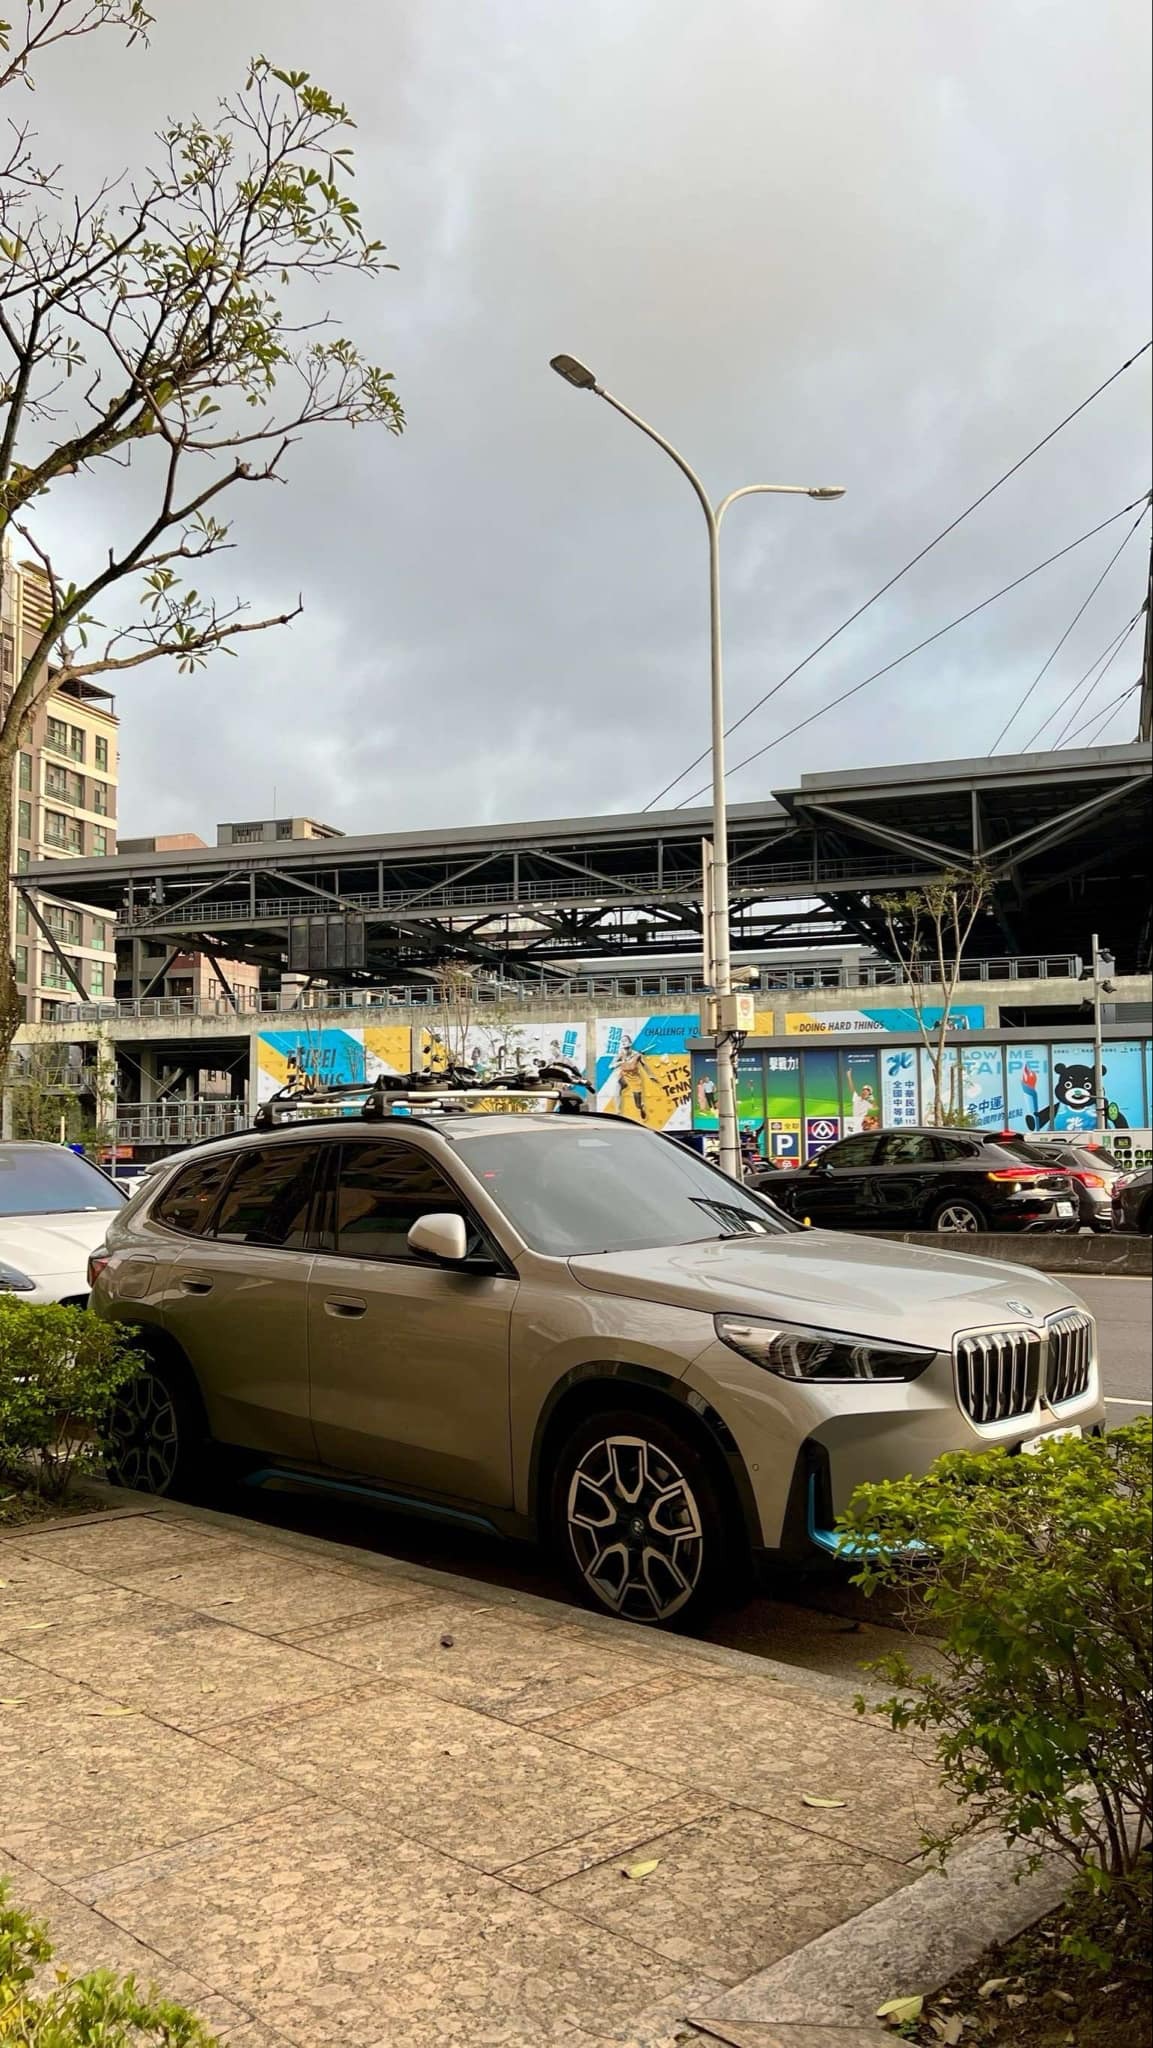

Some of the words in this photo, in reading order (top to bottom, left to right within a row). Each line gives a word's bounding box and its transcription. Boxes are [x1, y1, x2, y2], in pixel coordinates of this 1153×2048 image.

[644, 1026, 685, 1036] CHALLENGE
[799, 1022, 826, 1032] DOING
[828, 1021, 851, 1031] HARD
[854, 1020, 884, 1030] THINGS
[1009, 1049, 1034, 1059] ME
[963, 1060, 1049, 1075] TAIPEI
[967, 1096, 1004, 1114] 全中運
[776, 1134, 794, 1156] P
